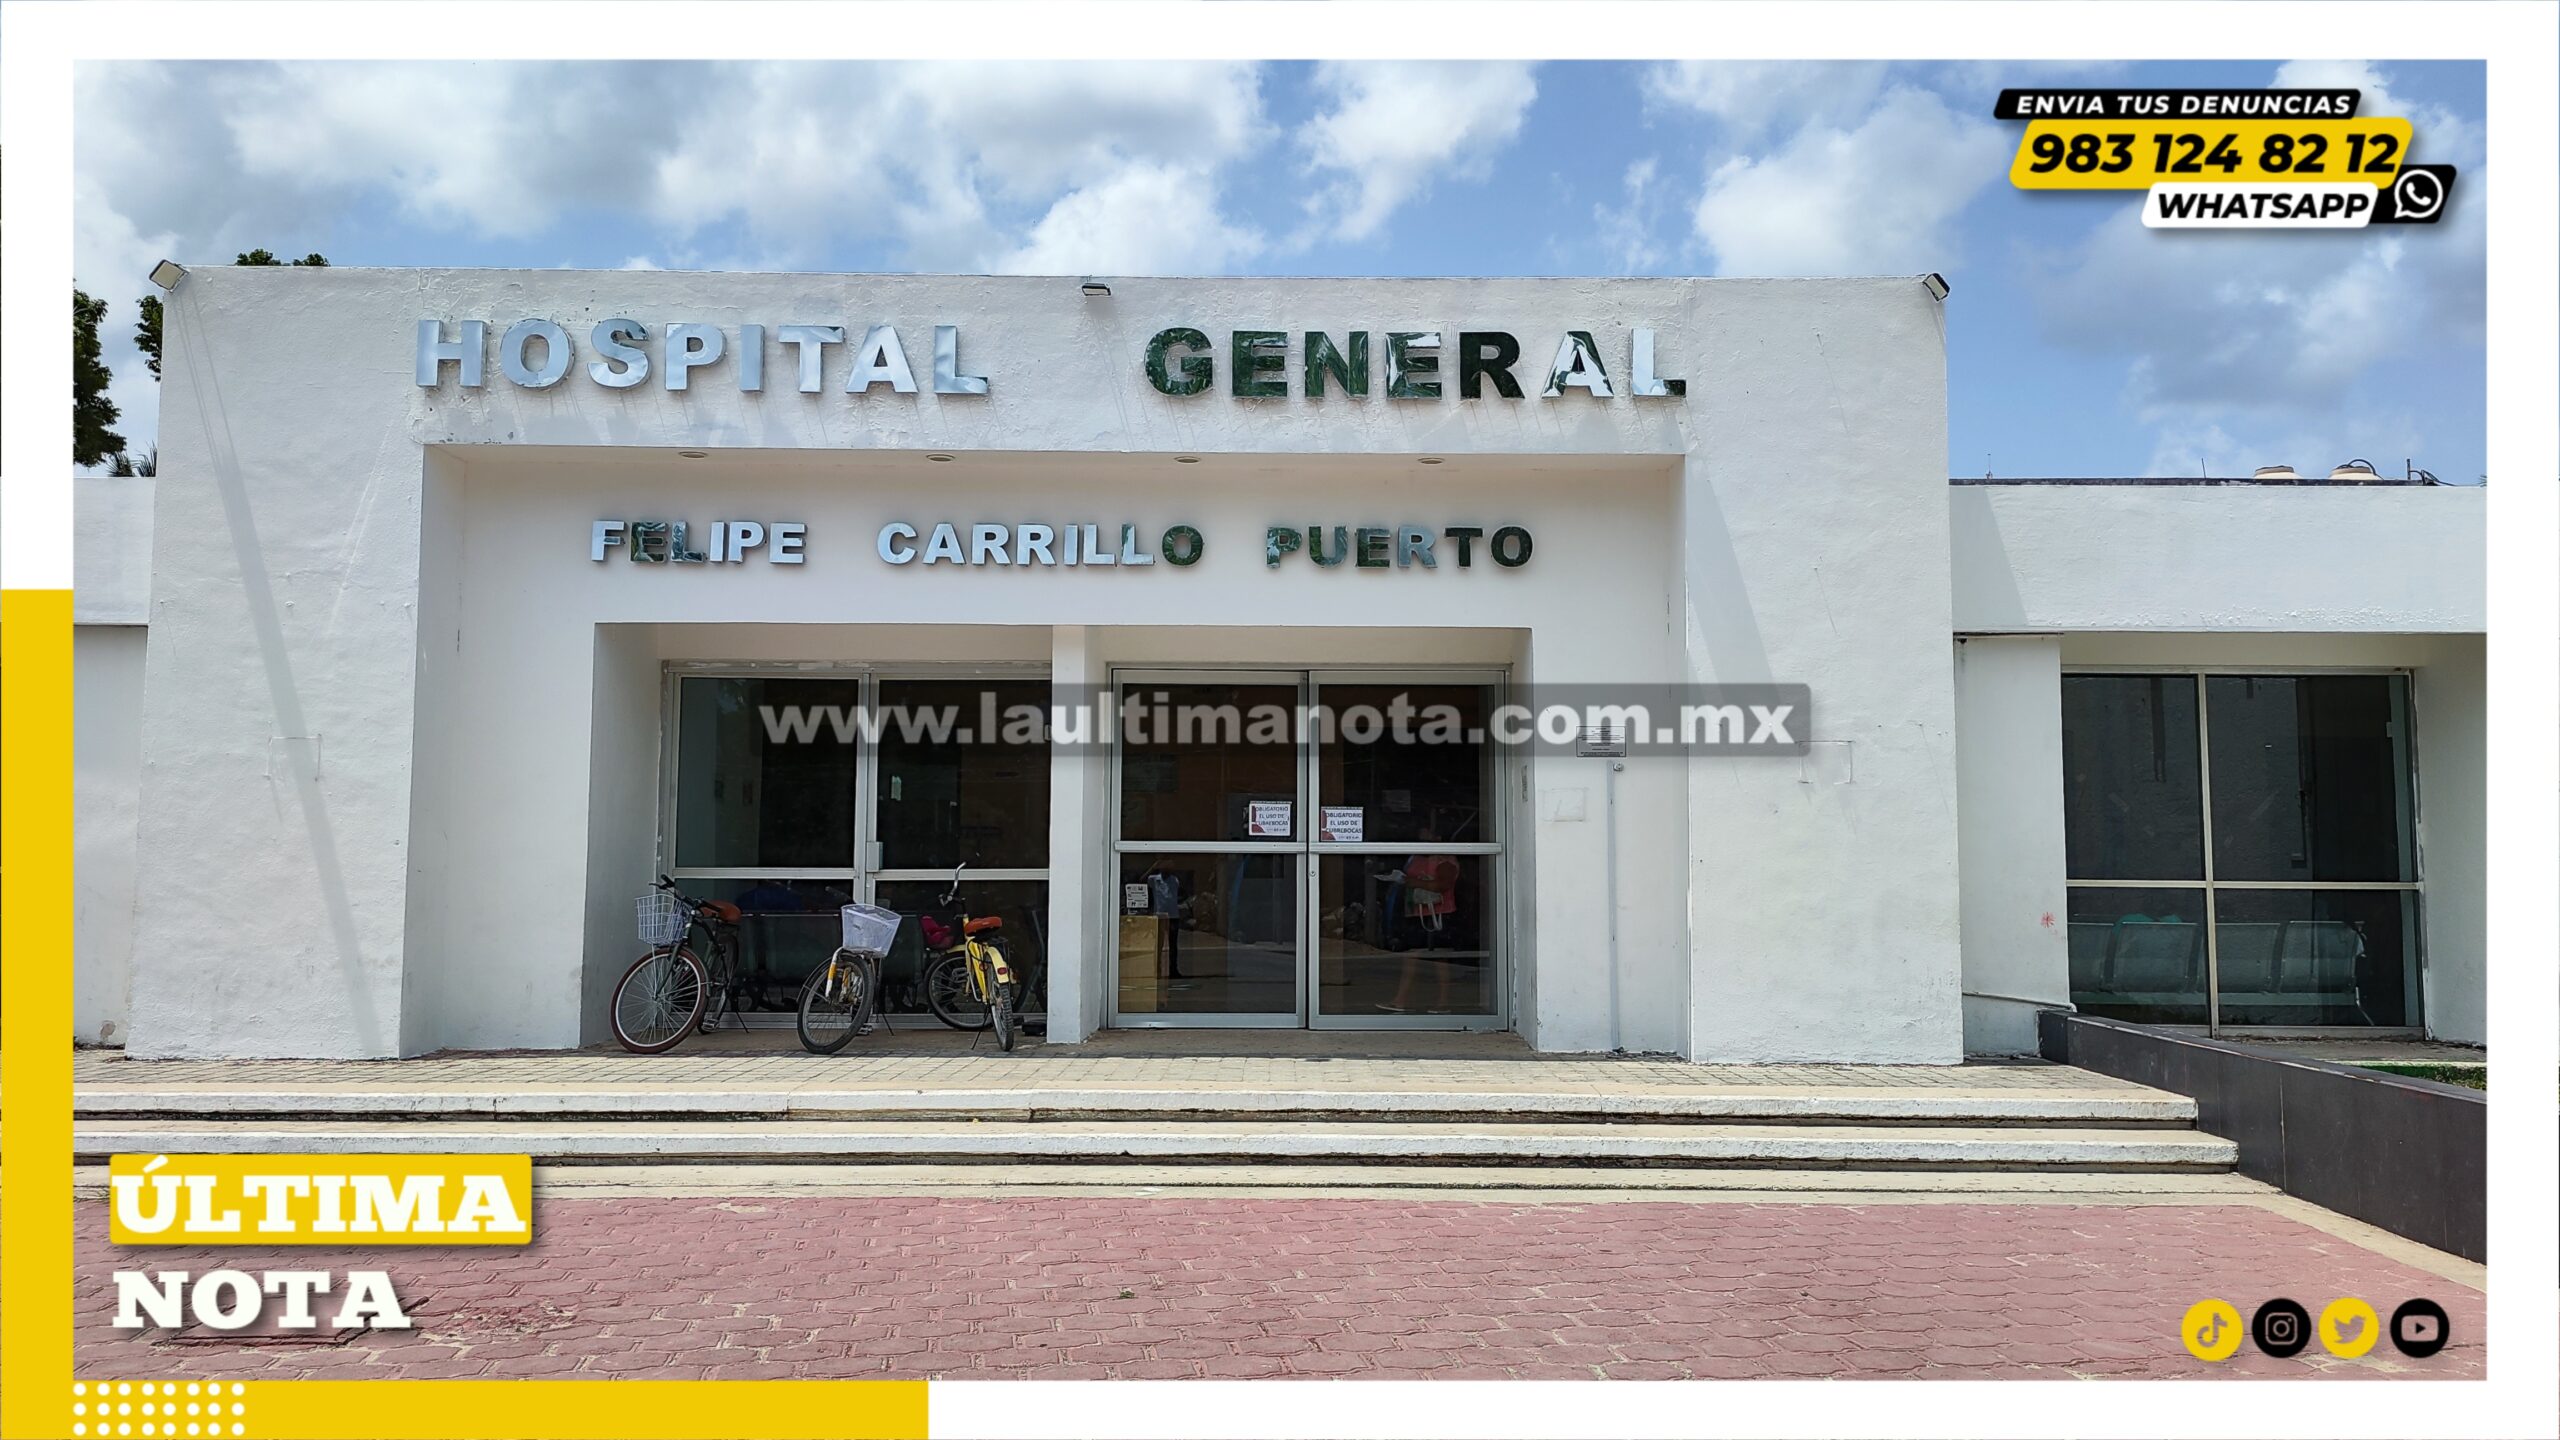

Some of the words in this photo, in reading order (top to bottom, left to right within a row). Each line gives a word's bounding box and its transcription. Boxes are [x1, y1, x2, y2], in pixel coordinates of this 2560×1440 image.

[416, 318, 990, 396] HOSPITAL
[1143, 327, 1687, 400] GENERAL
[590, 520, 806, 565] FELIPE
[876, 522, 1205, 568] CARRILLO
[1265, 525, 1534, 569] PUERTO
